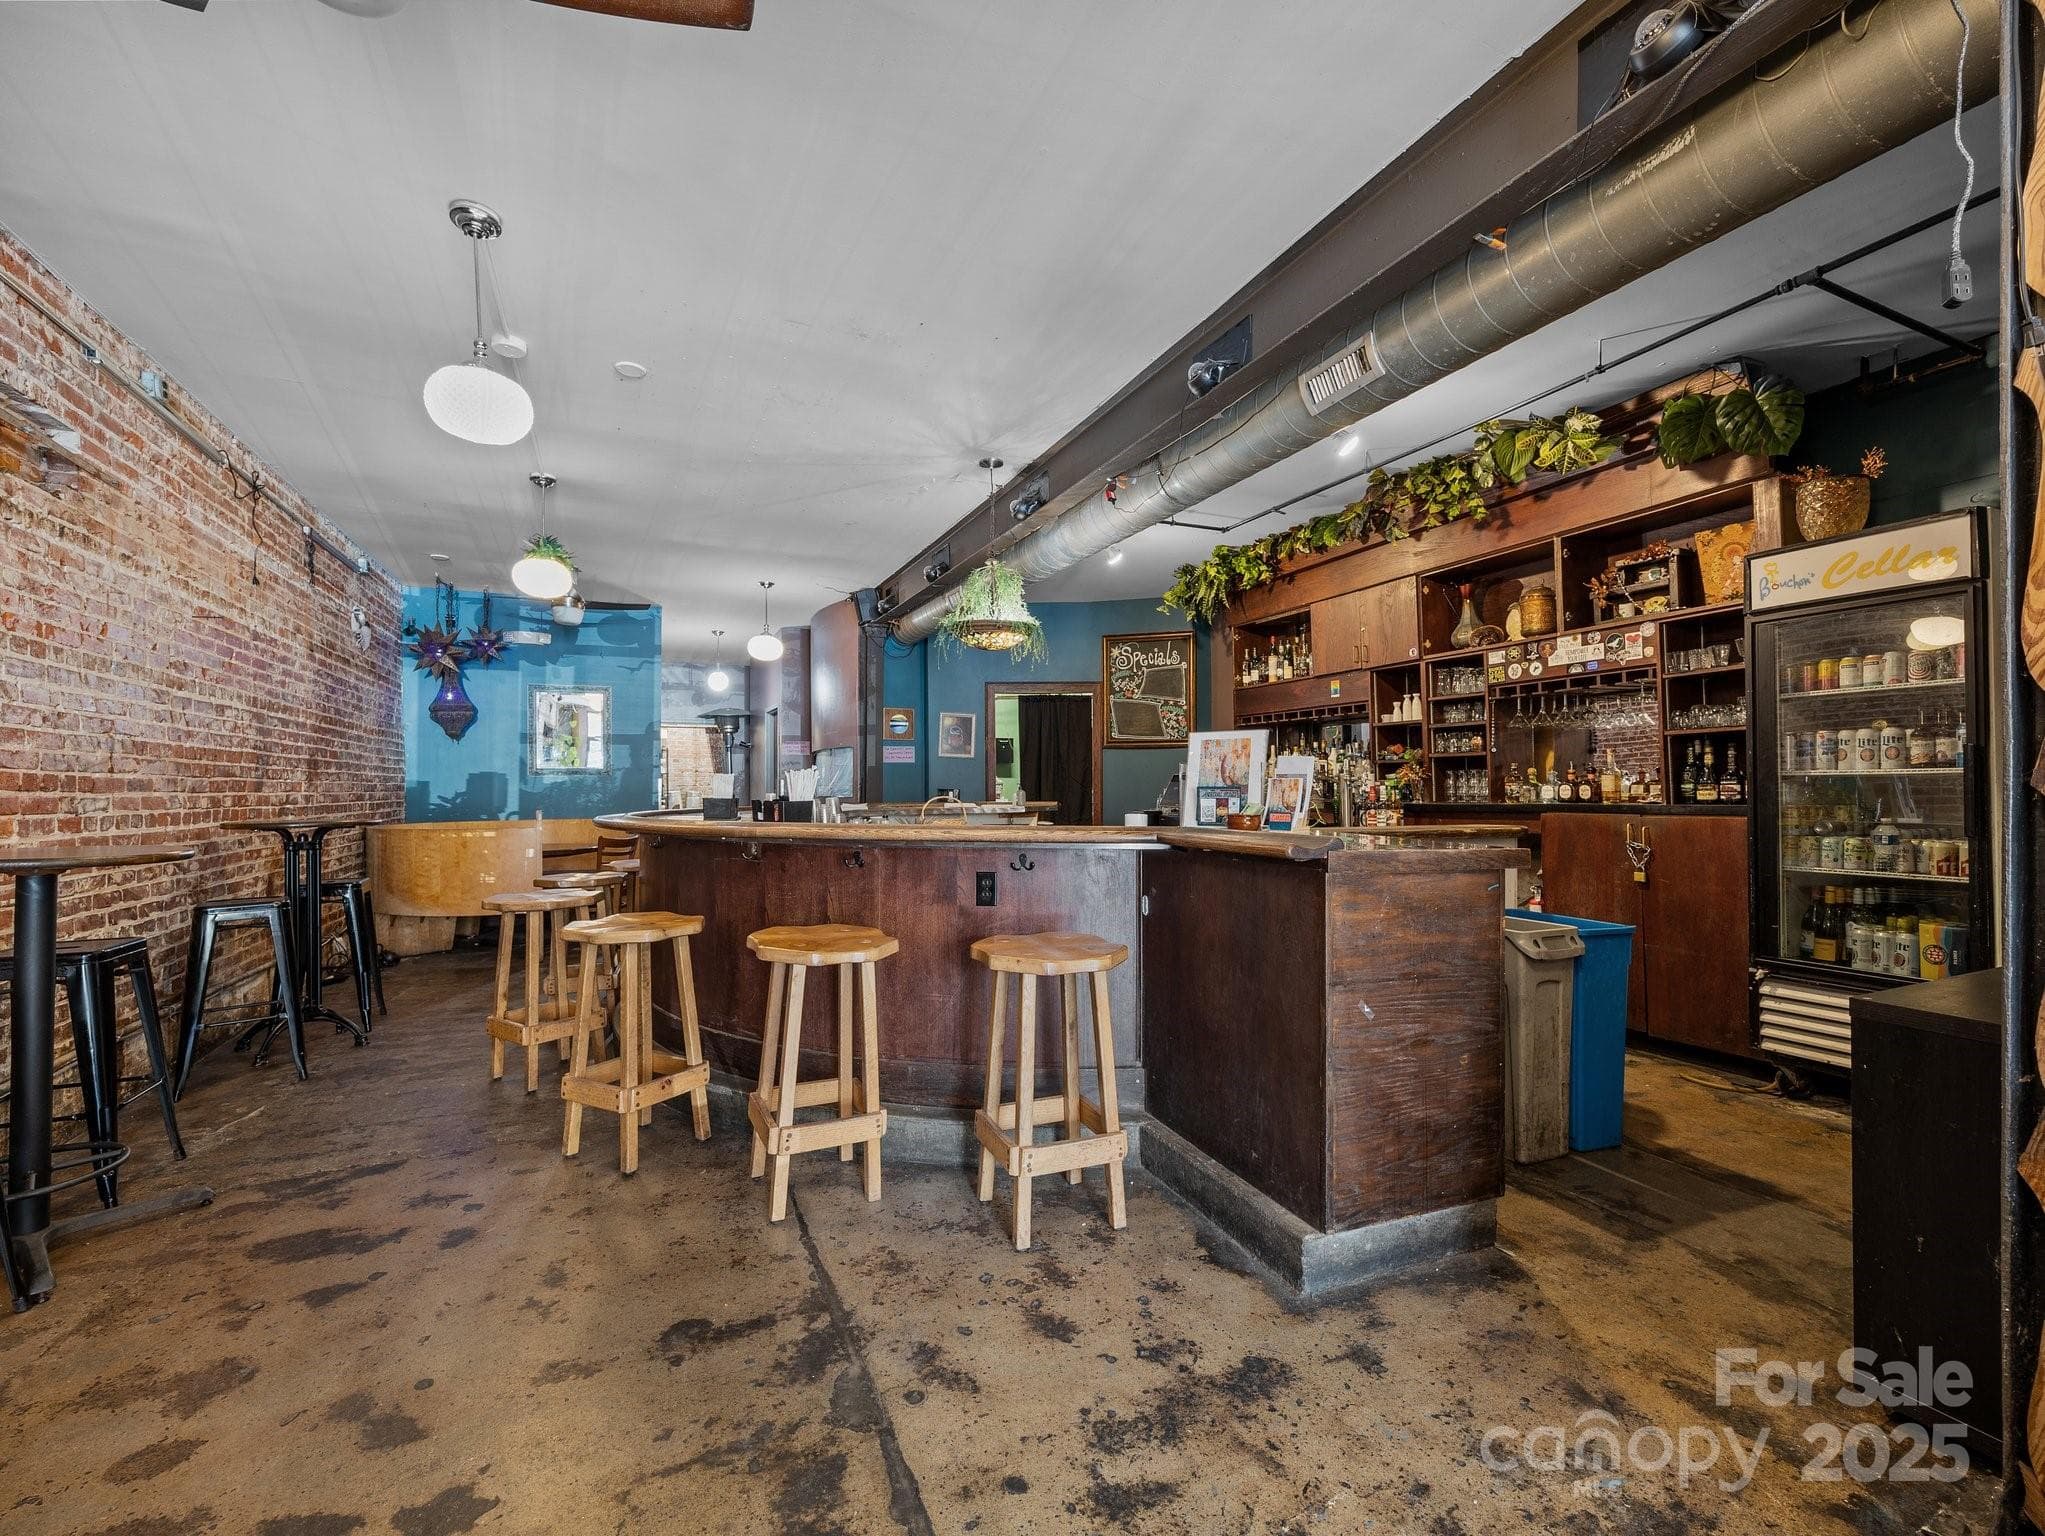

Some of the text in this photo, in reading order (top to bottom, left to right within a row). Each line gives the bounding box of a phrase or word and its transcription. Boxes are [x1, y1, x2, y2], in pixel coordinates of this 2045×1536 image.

[1821, 543, 1960, 590] Cellar
[1115, 641, 1181, 672] Specials
[1882, 735, 1904, 746] Lite
